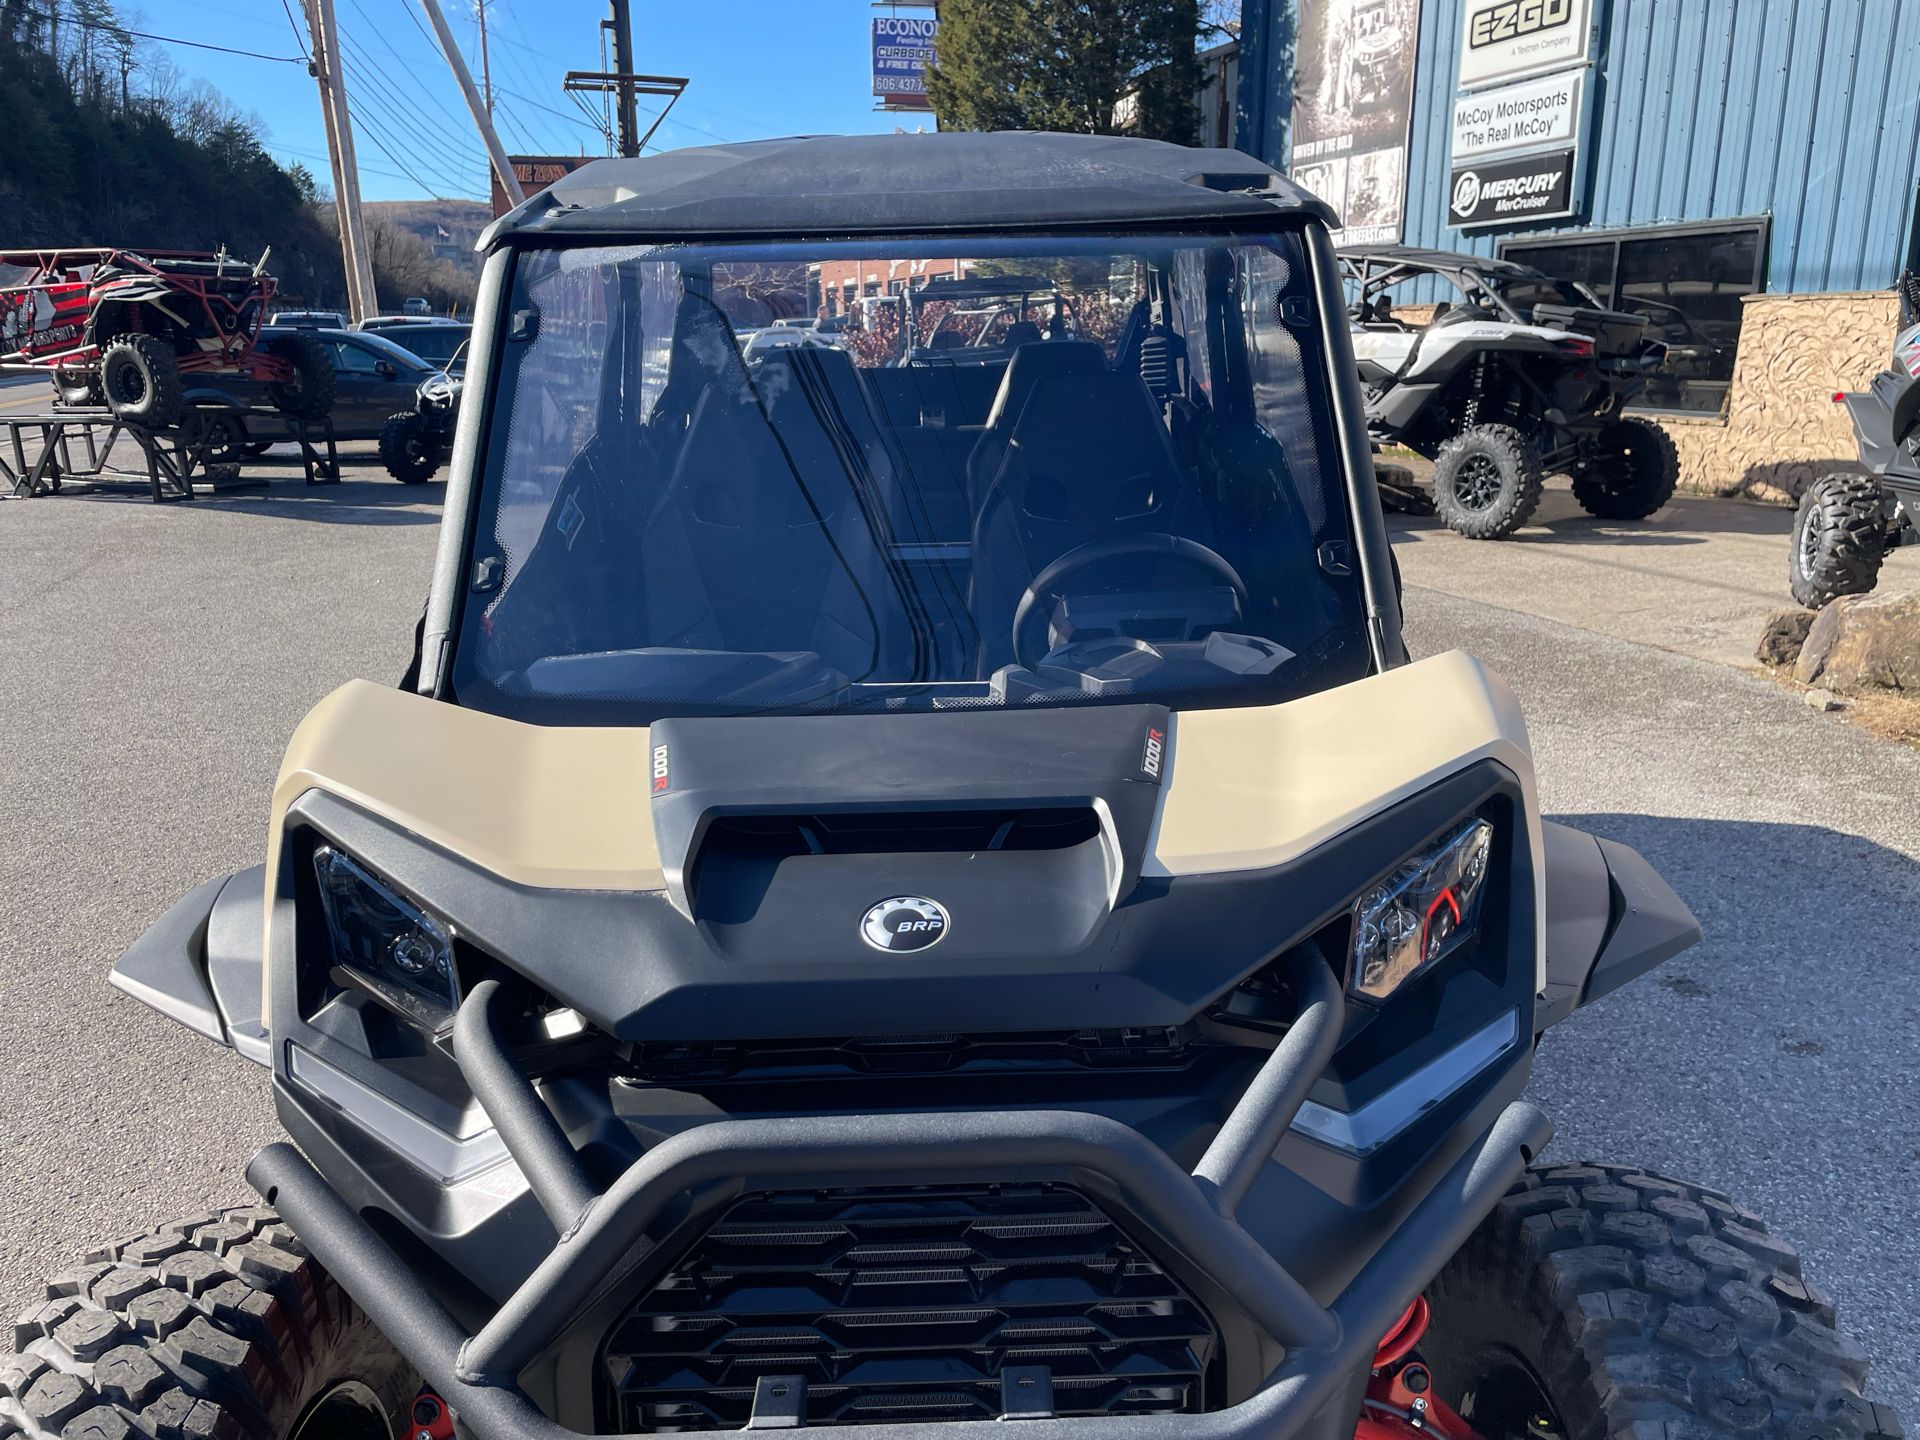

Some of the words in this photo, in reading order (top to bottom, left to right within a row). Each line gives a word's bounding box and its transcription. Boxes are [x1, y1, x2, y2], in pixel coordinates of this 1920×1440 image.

[1470, 0, 1571, 48] EZGO
[878, 47, 932, 58] CURBSIDE
[1511, 48, 1517, 56] A
[1518, 43, 1540, 55] Textron
[1541, 35, 1572, 49] Company
[877, 60, 885, 68] &
[886, 60, 909, 69] FREE
[1457, 107, 1494, 128] McCoy
[1496, 91, 1568, 119] Motorsports
[1487, 124, 1511, 143] Real
[1514, 114, 1559, 137] McCoy"
[1480, 171, 1562, 200] MERCURY
[1495, 195, 1550, 212] MerCruiser
[1144, 728, 1163, 777] 1000R
[653, 744, 668, 792] 1000R
[897, 921, 942, 933] BRP
